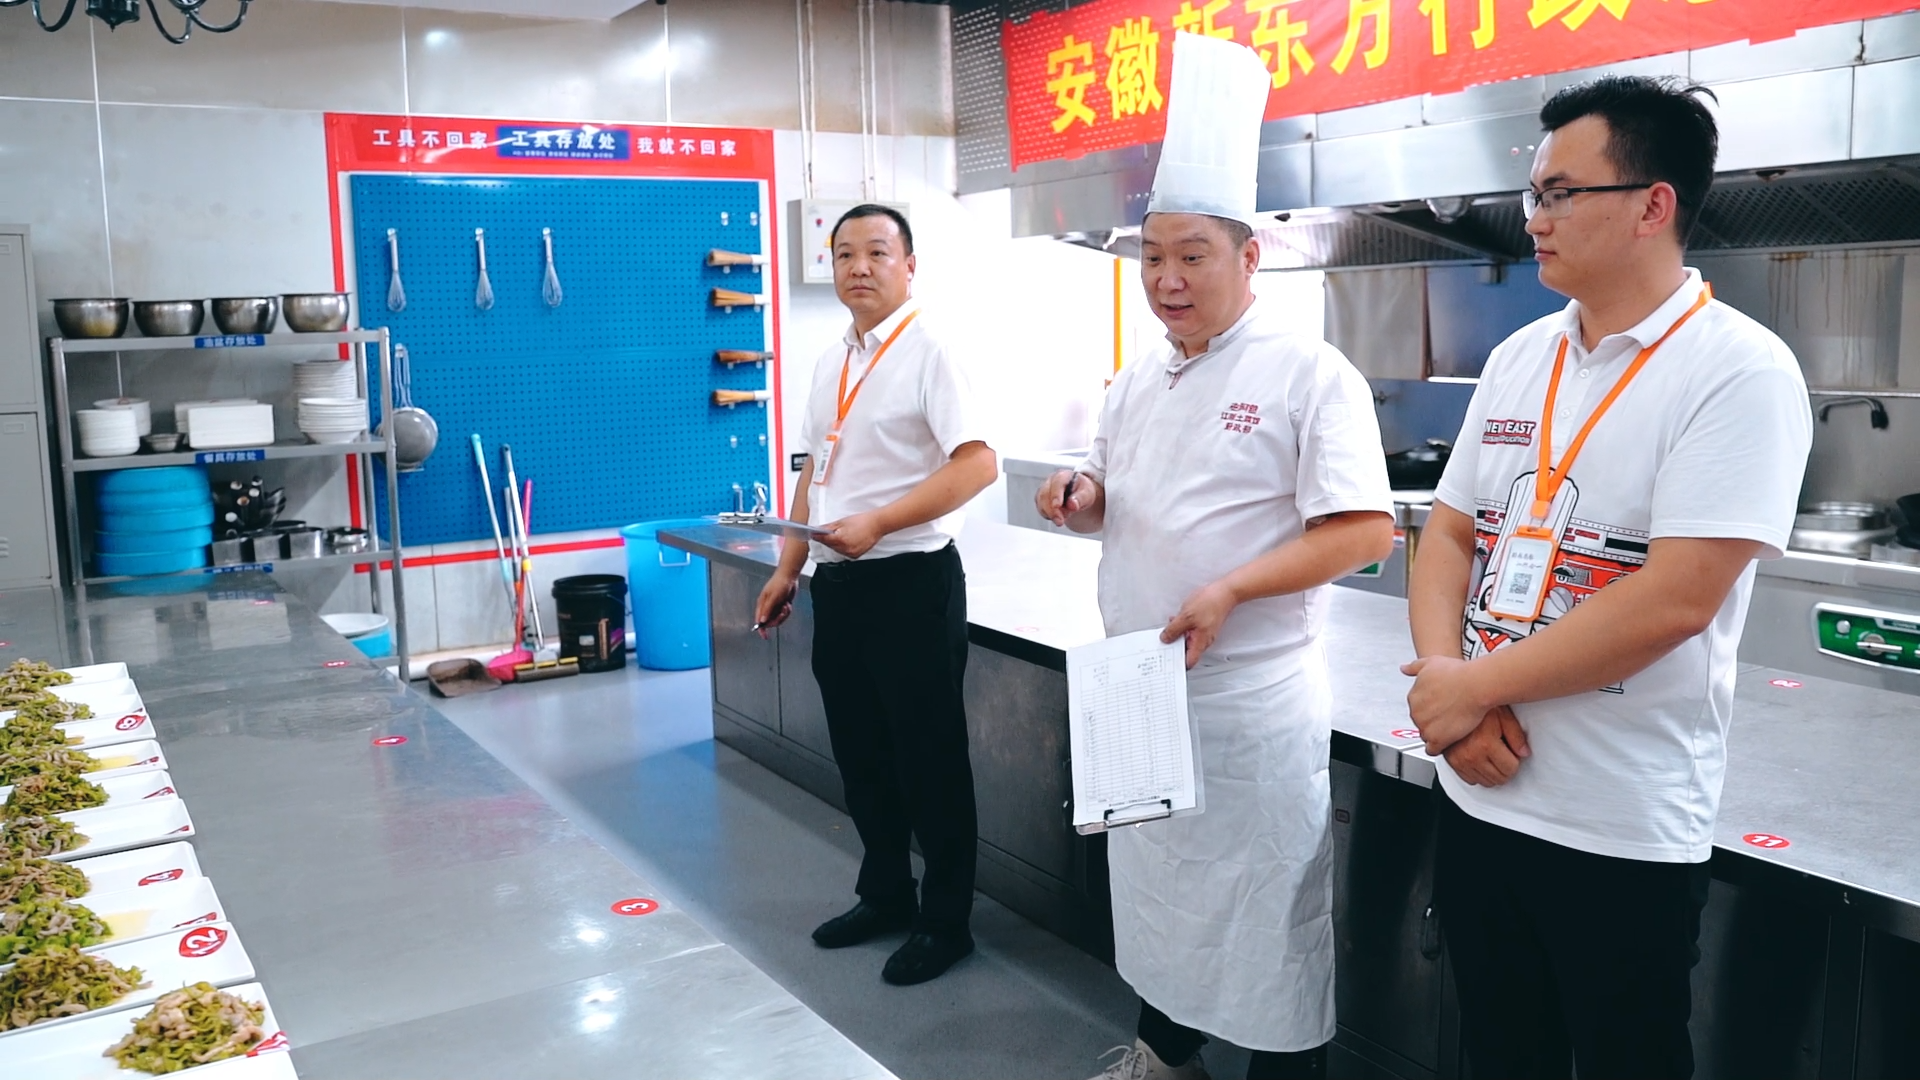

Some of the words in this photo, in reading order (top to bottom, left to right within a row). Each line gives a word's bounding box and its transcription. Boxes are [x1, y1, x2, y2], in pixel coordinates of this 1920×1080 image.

[372, 128, 488, 150] 工具不回家
[511, 130, 616, 150] 工具存放处
[636, 136, 737, 157] 我就不回家
[1504, 421, 1535, 435] EAST
[621, 902, 649, 912] 3
[185, 929, 224, 955] 12
